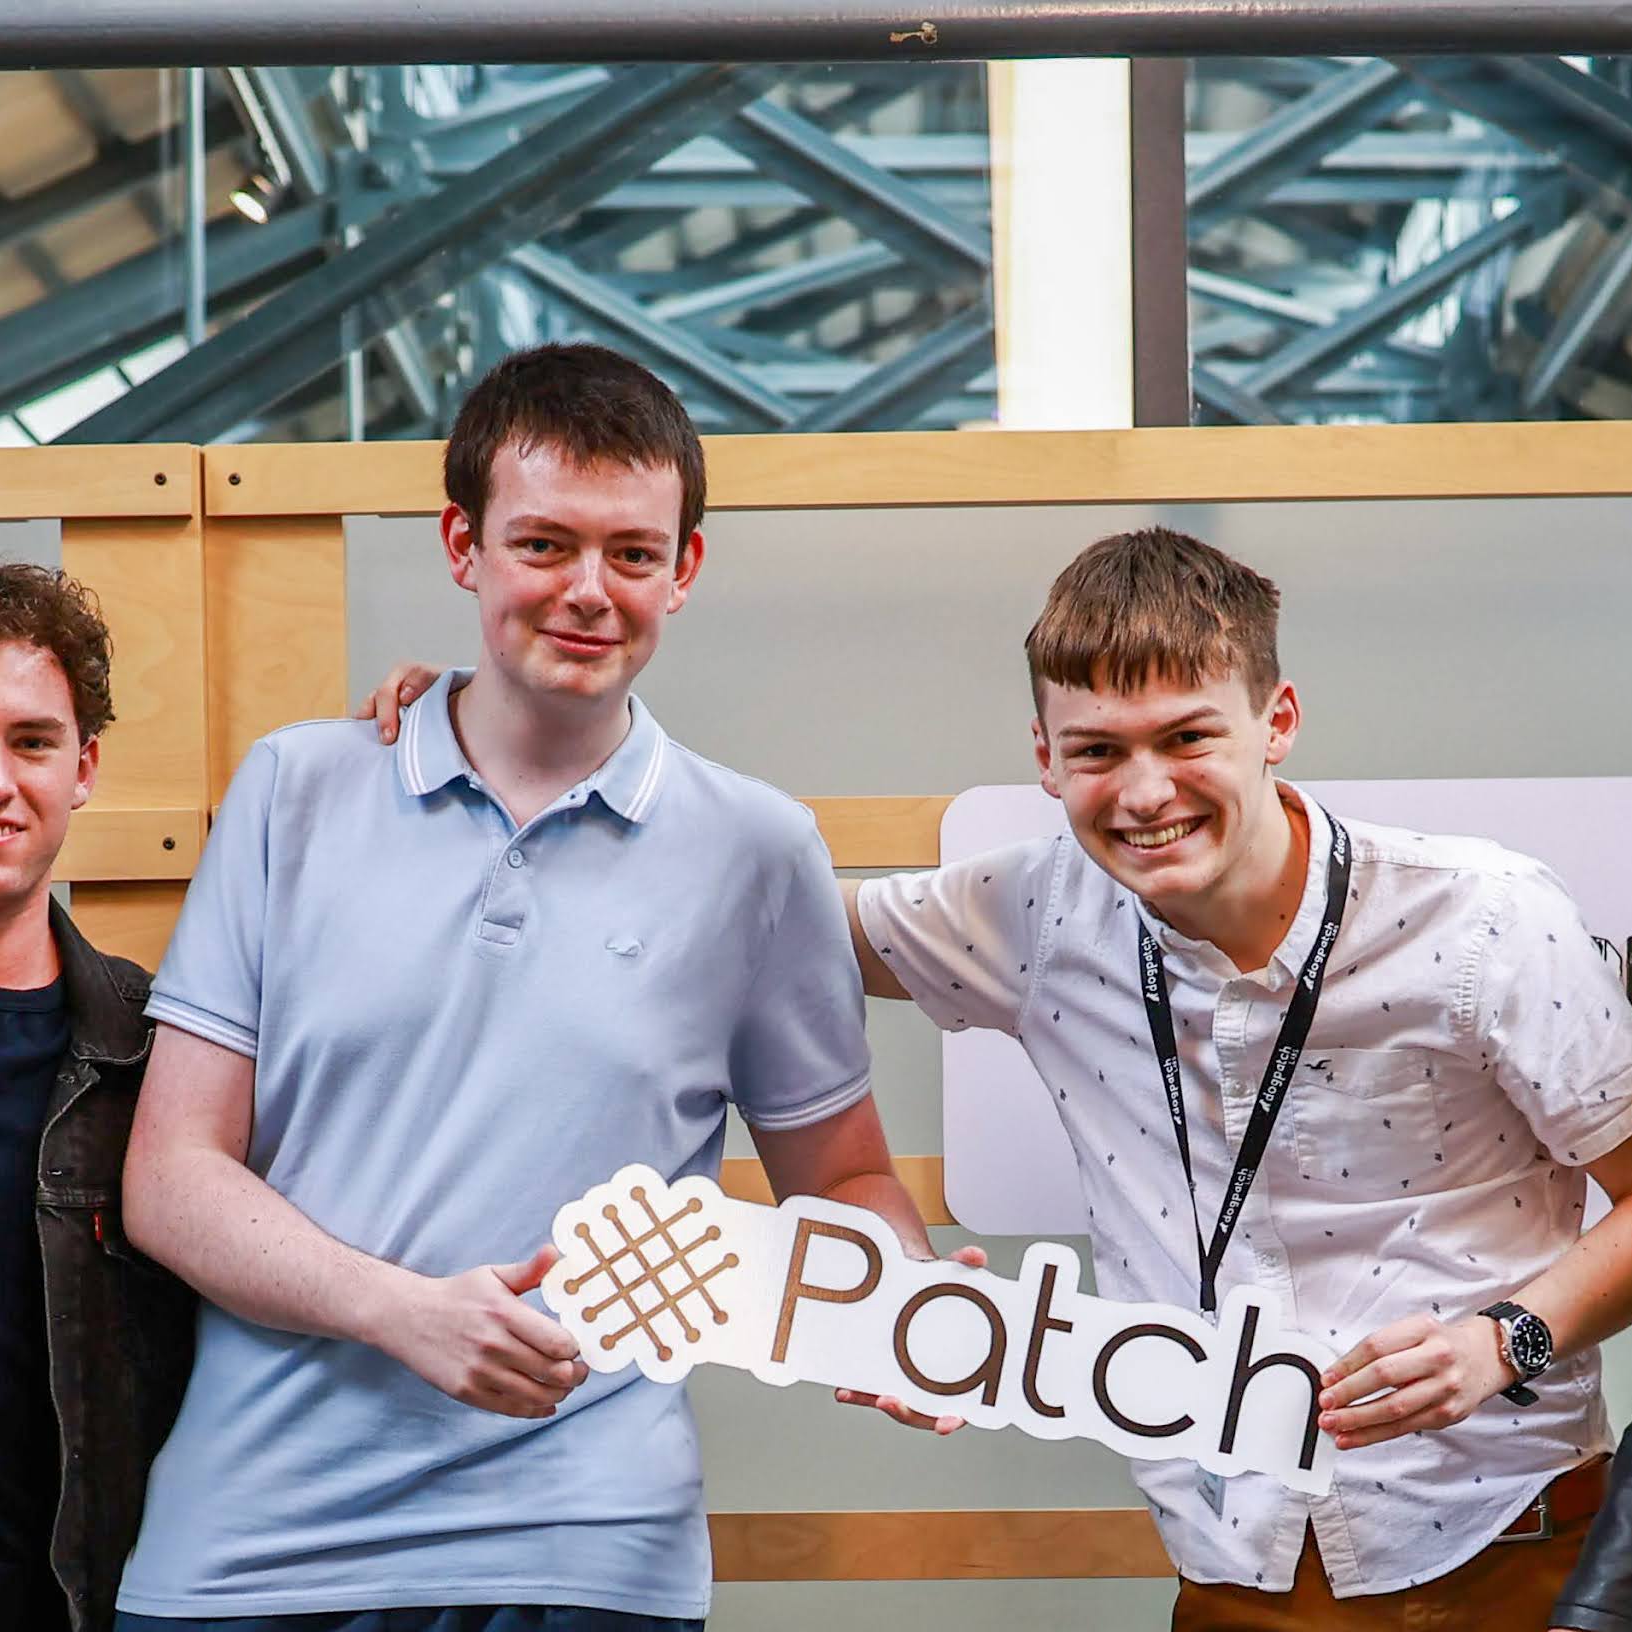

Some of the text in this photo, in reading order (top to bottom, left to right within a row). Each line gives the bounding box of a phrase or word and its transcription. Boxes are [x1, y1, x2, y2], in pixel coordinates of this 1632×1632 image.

[1141, 936, 1158, 991] dogpatch
[1307, 922, 1334, 978] dogpatch
[1163, 1058, 1180, 1115] dogpatch
[1266, 1045, 1292, 1102] dogpatch
[1222, 1167, 1249, 1224] dogpatch
[770, 1217, 1322, 1471] Patch
